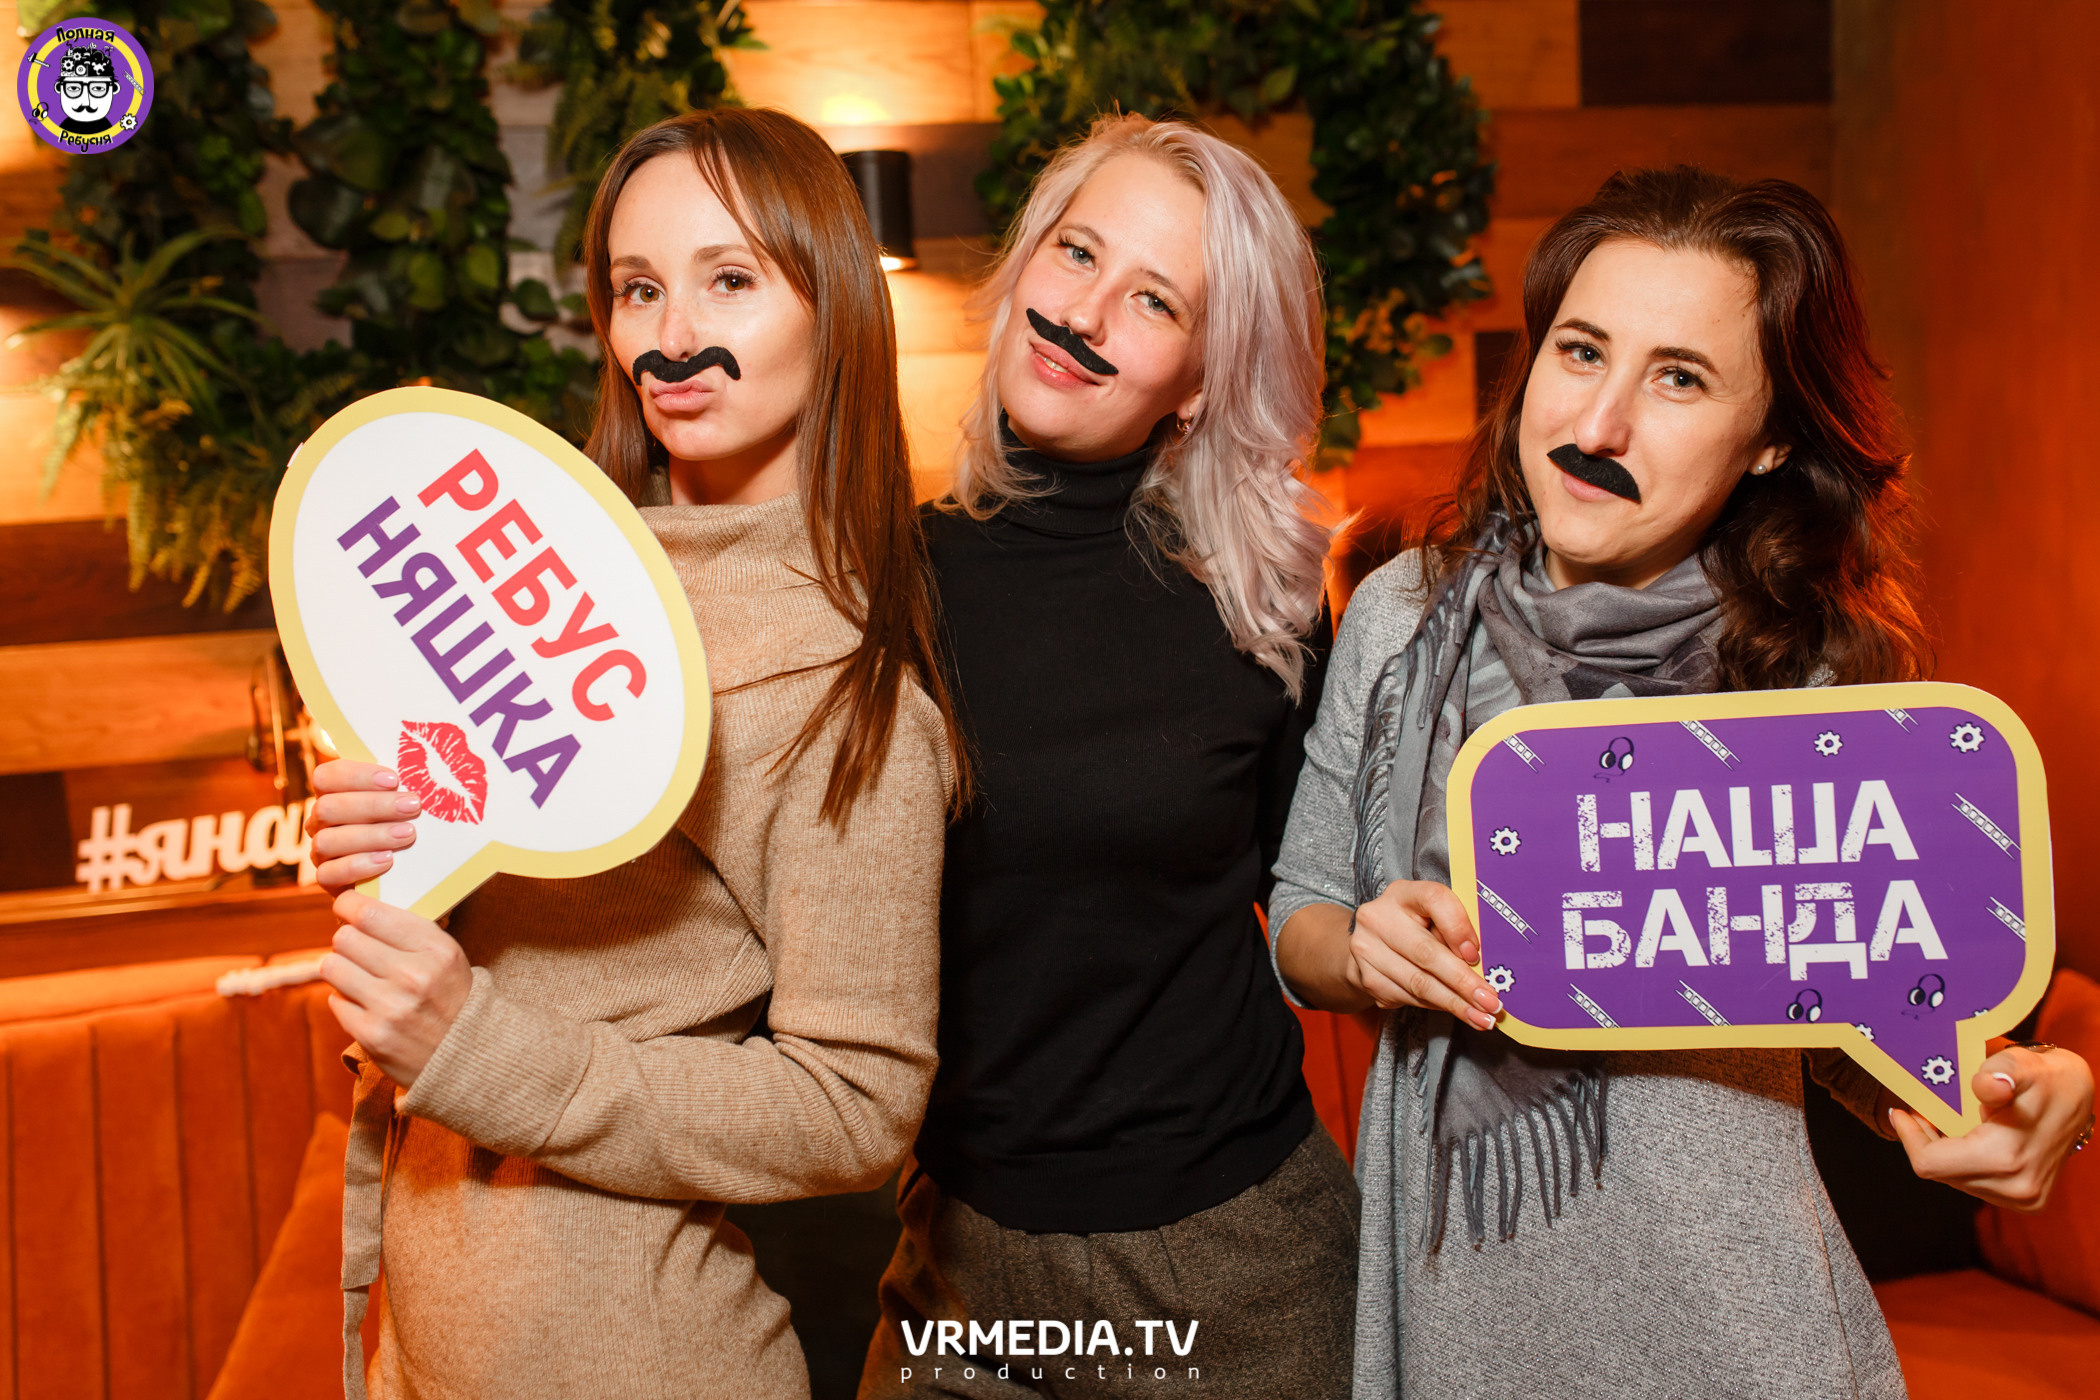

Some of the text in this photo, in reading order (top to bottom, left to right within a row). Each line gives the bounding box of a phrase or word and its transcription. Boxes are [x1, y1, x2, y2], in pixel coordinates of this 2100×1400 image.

[337, 495, 581, 810] НЯШКА
[417, 448, 647, 722] РЕБУС
[1576, 779, 1920, 873] НАША
[1561, 879, 1949, 981] БАНДА
